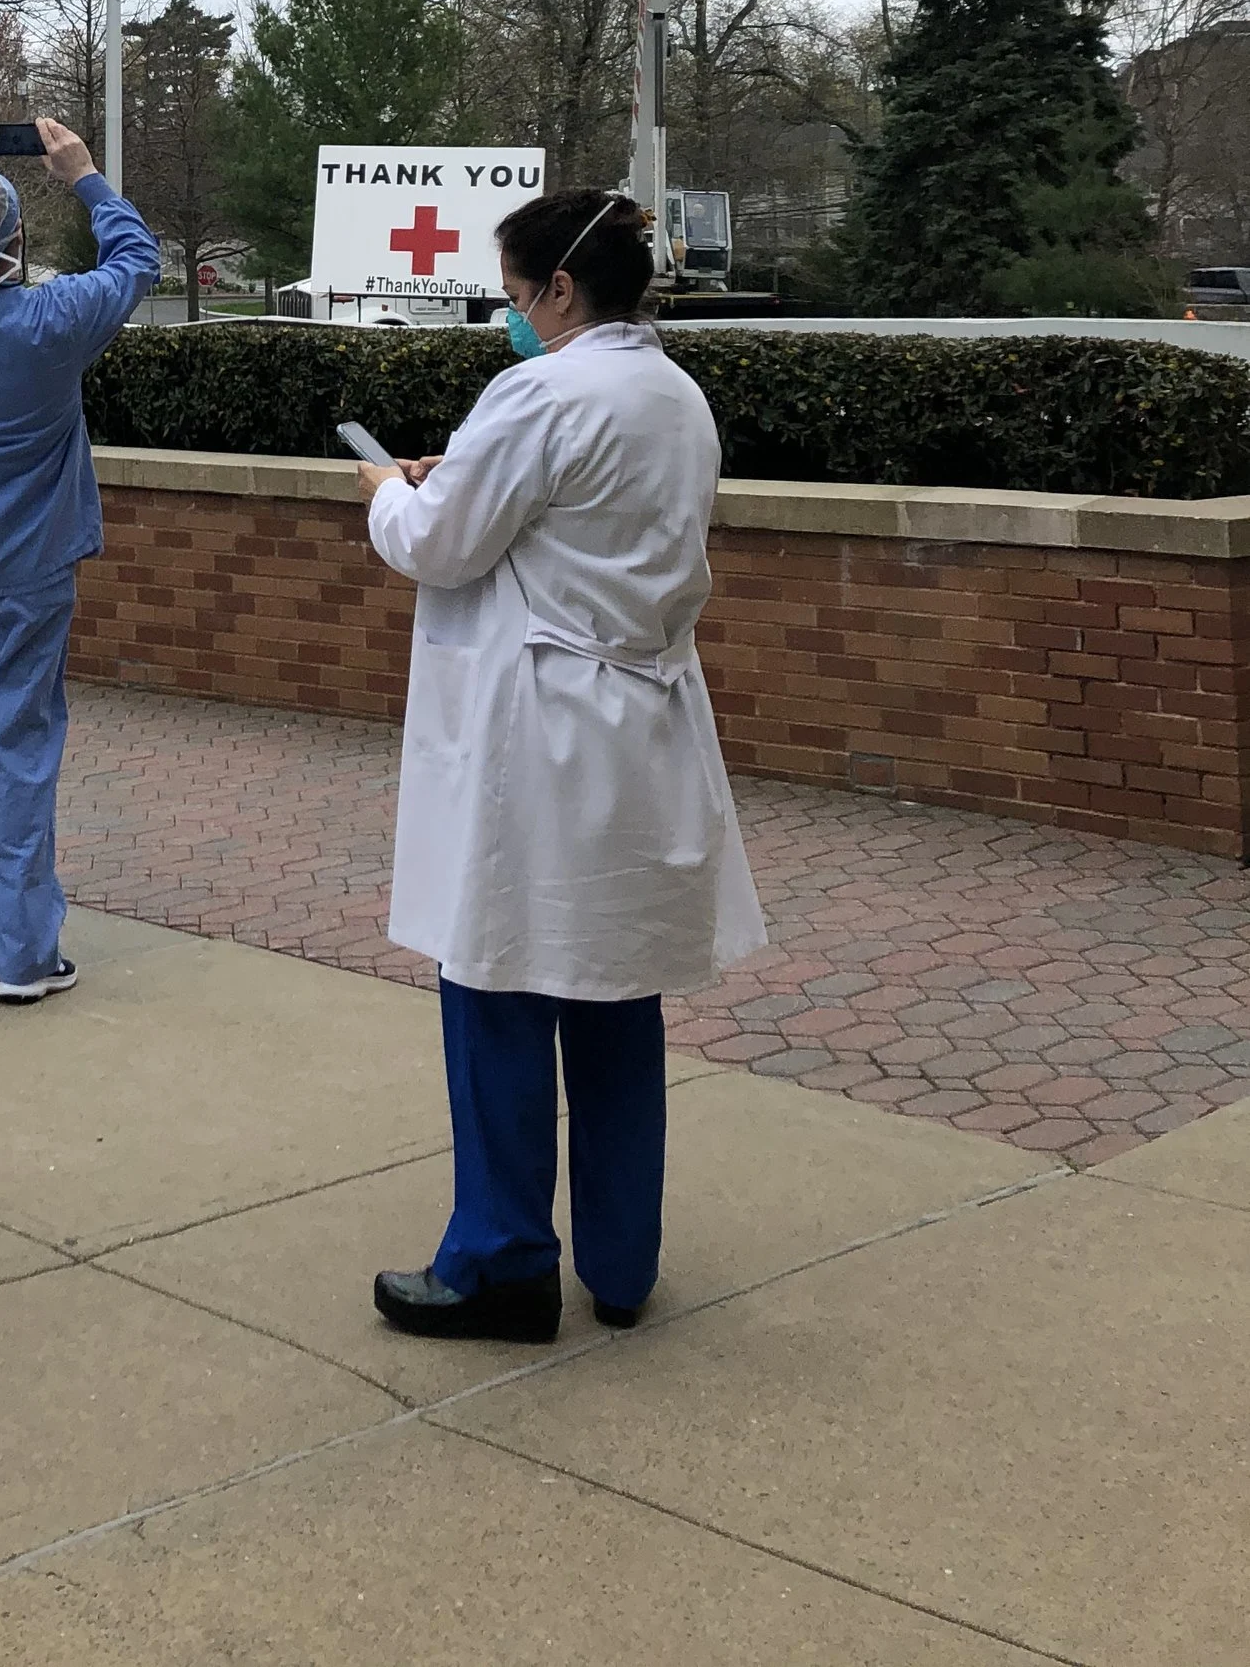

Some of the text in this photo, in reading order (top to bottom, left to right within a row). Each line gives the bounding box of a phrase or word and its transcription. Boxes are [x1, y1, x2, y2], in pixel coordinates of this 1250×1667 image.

[322, 163, 540, 188] THANK YOU
[198, 271, 216, 280] STOP
[365, 275, 480, 295] #ThankYouTour
